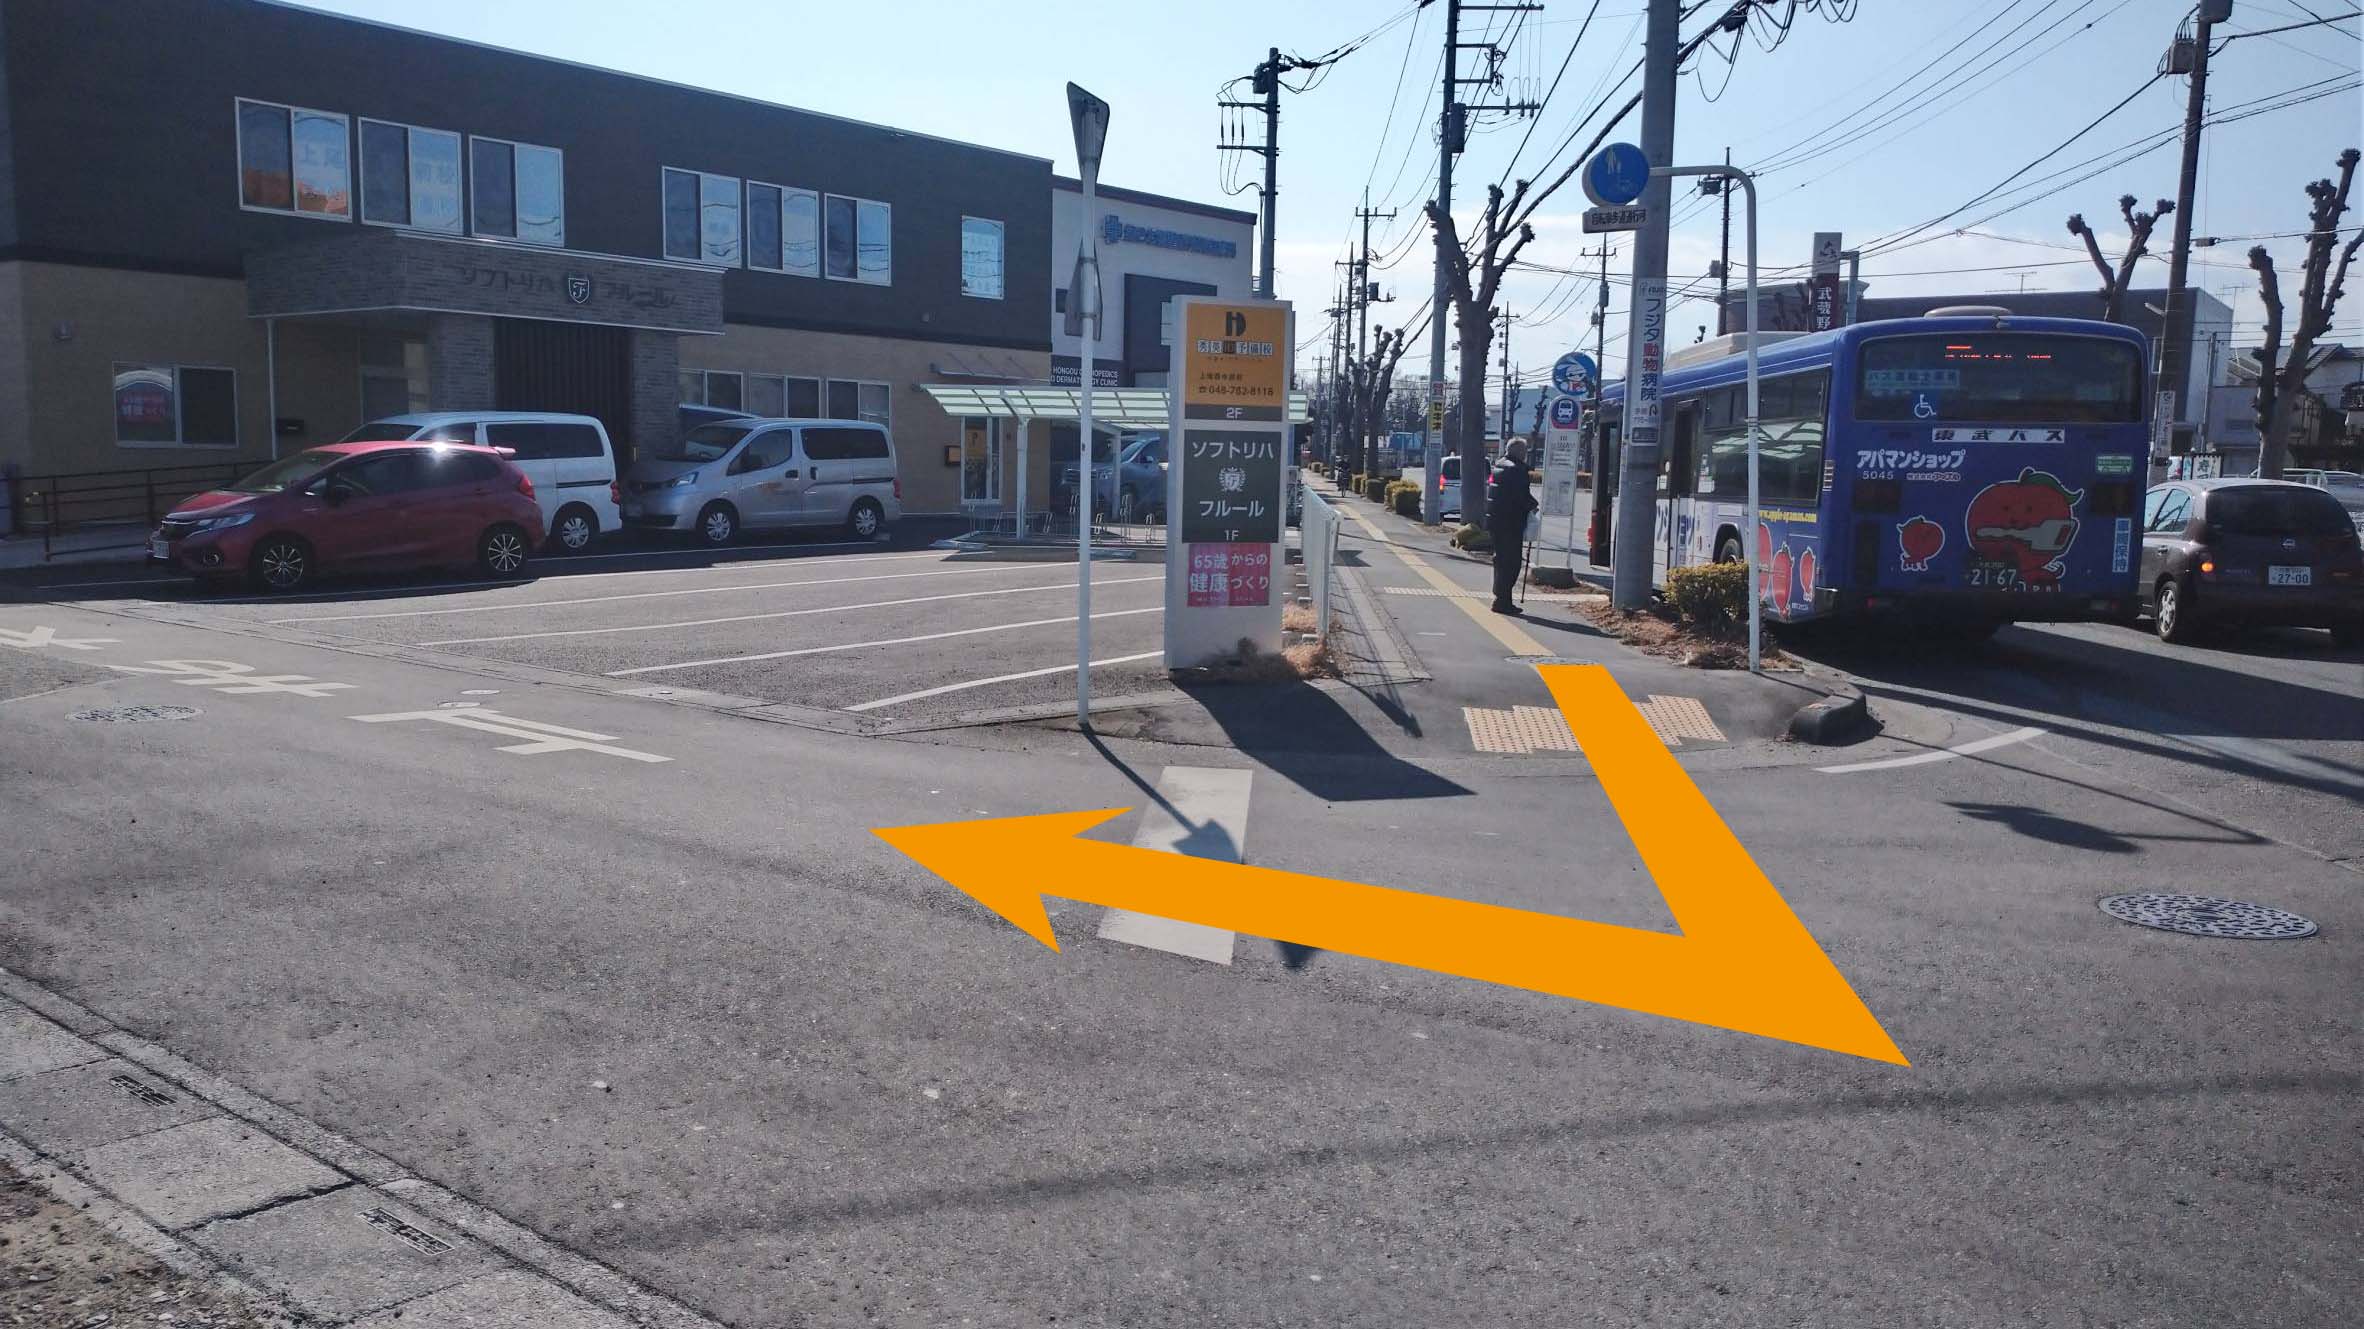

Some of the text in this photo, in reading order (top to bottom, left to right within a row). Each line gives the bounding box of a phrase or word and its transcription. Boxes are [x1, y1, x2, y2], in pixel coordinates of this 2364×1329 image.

[1640, 298, 1661, 401] フジタ動物病院
[1225, 407, 1243, 419] 2F
[1934, 429, 2063, 441] 東武バス
[1192, 440, 1274, 459] ソフトリハ
[1857, 449, 1966, 469] アパマンショップ
[1862, 470, 1894, 480] 5045
[1199, 499, 1265, 518] フルール
[1224, 529, 1239, 541] 1F
[1190, 573, 1269, 593] 健康づくり
[2277, 573, 2309, 584] 27-00
